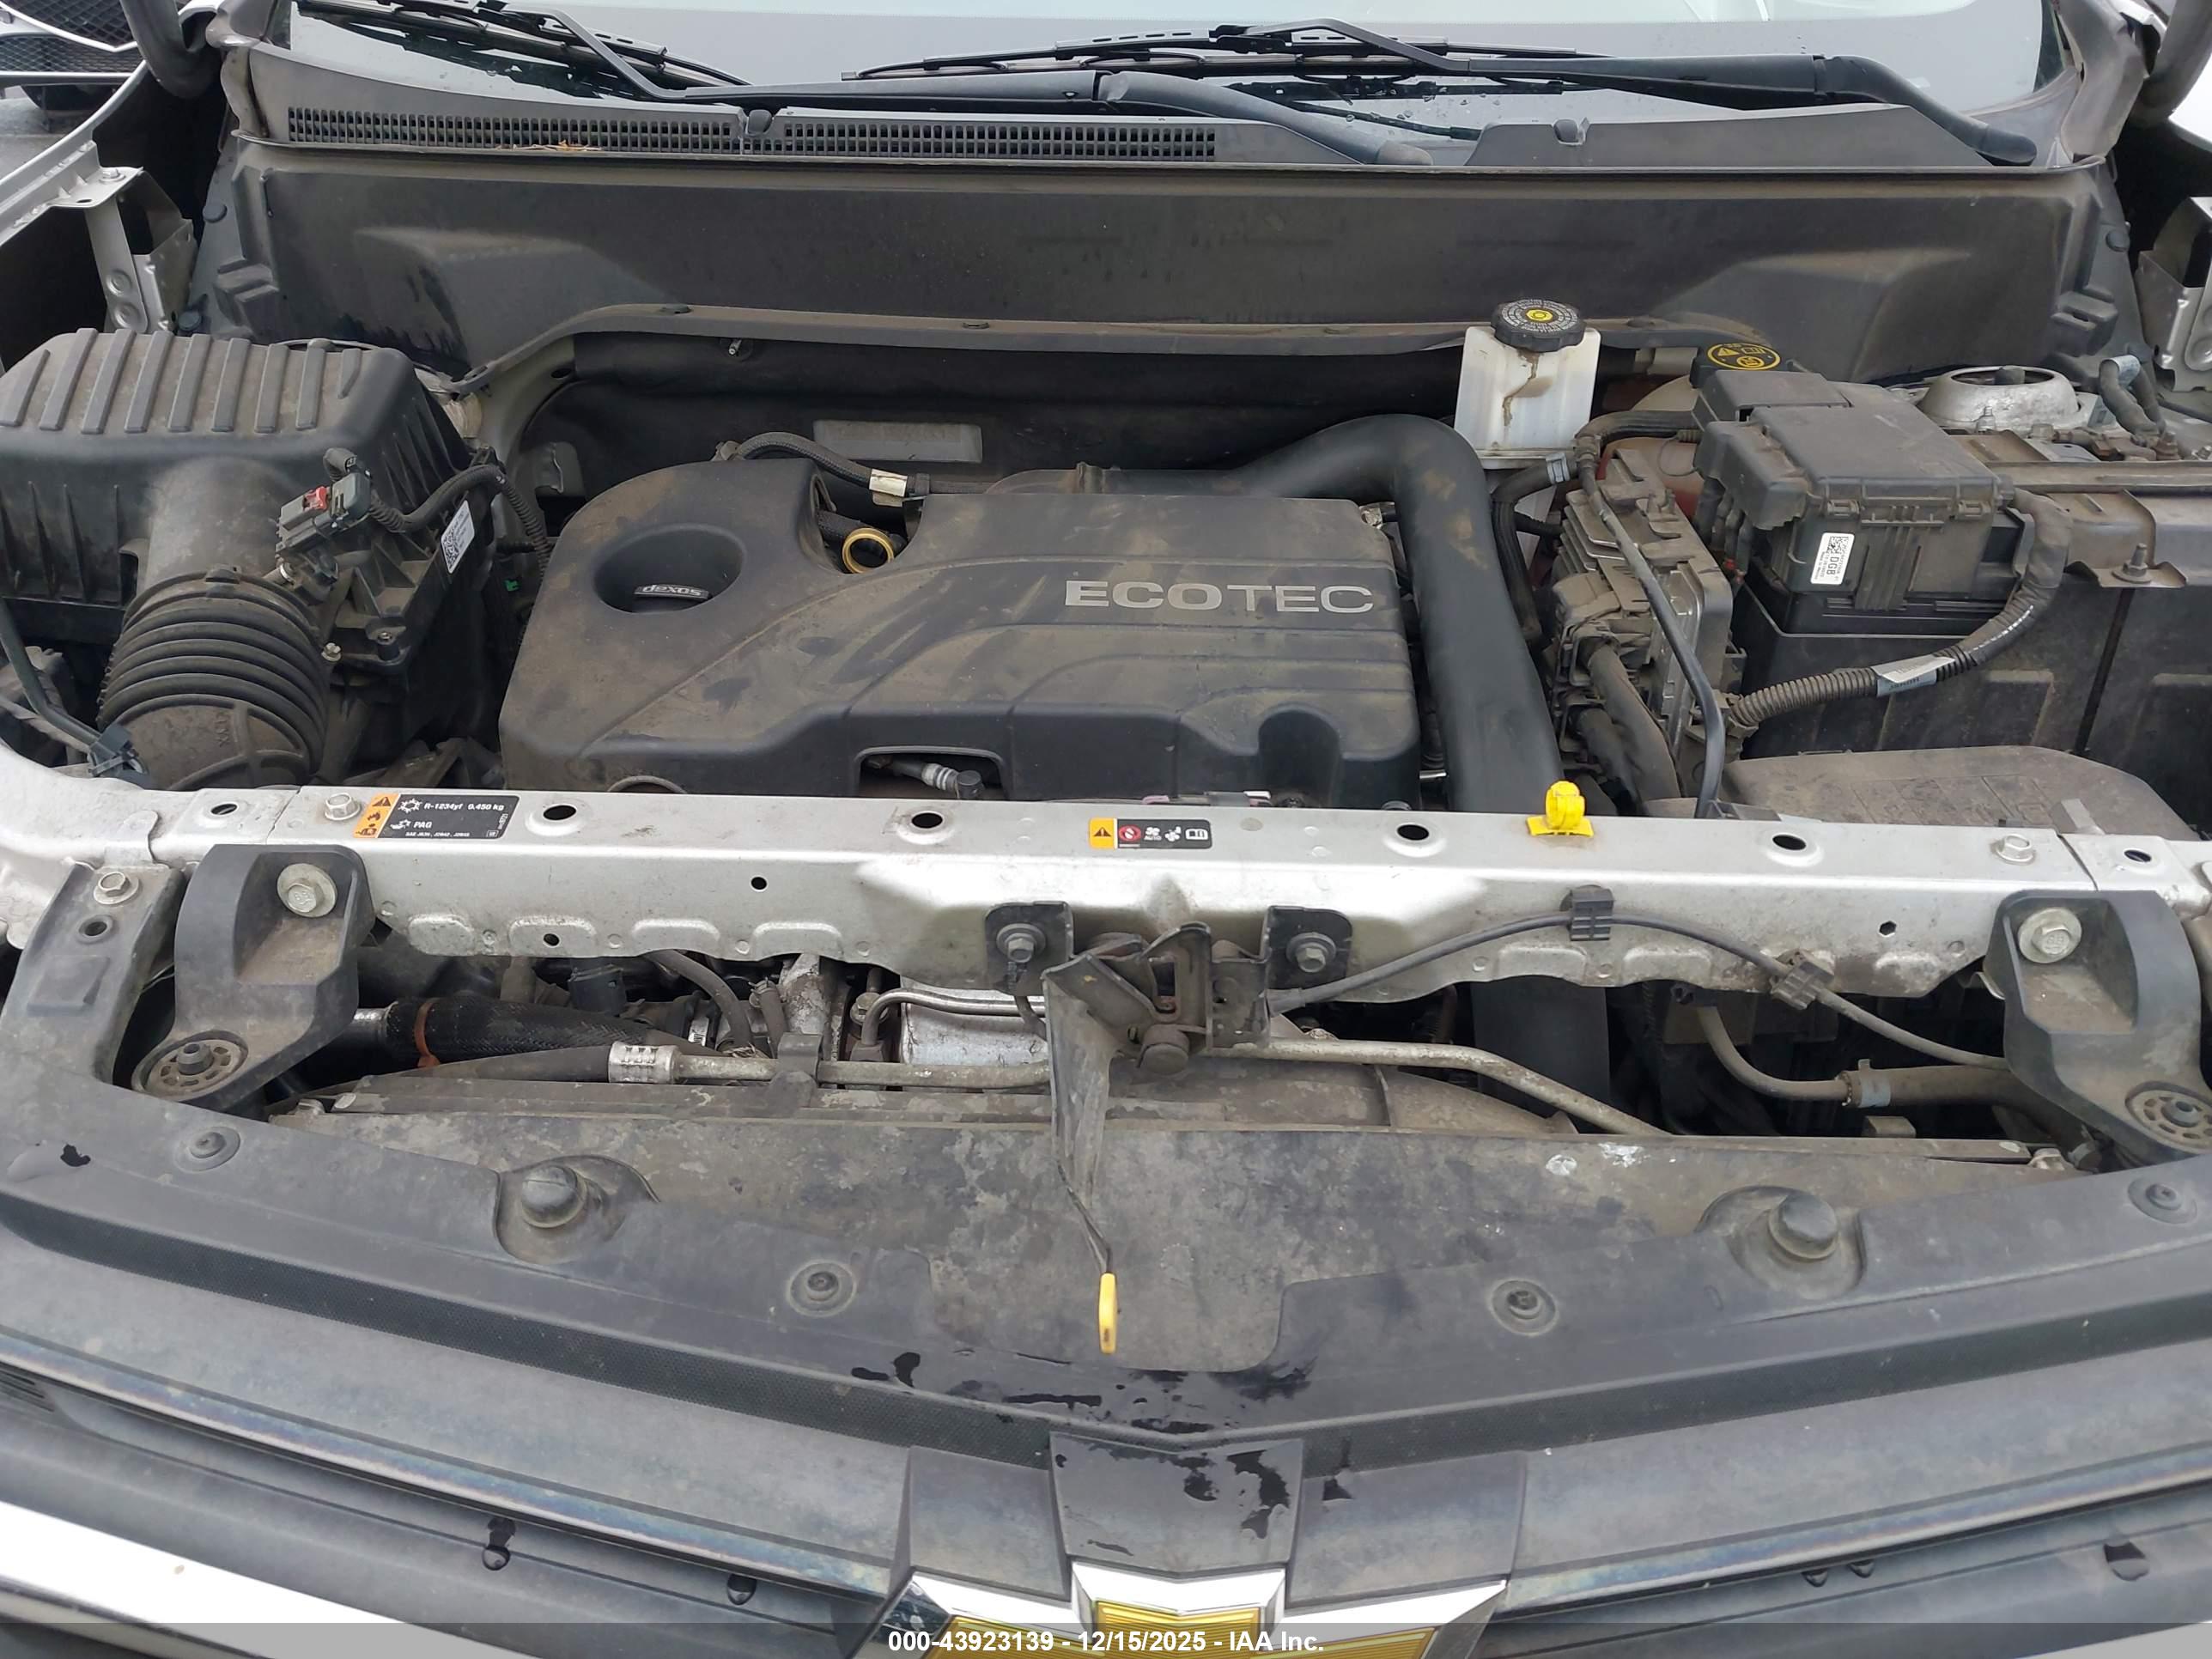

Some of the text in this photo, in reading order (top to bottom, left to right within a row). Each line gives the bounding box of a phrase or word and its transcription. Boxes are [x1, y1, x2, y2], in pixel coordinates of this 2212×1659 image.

[1826, 556, 1839, 574] DGB
[642, 585, 702, 596] dexos
[1065, 580, 1374, 613] ECOTEC
